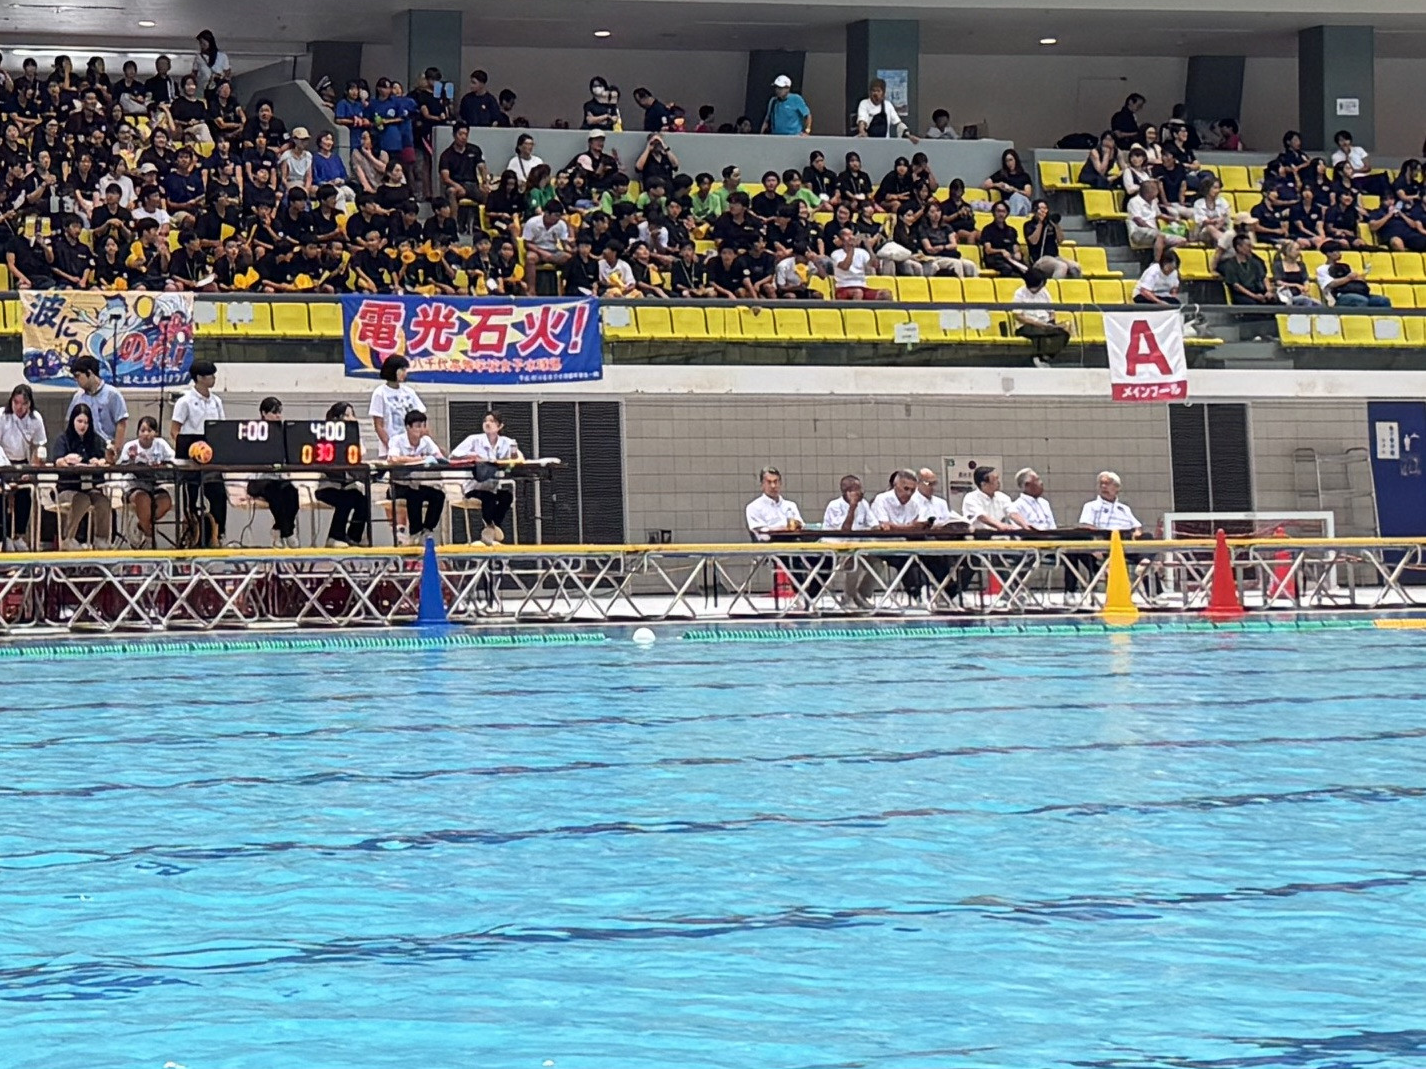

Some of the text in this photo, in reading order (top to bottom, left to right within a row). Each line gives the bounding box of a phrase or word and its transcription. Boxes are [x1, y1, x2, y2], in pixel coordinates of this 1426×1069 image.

[26, 293, 79, 338] 波に
[1126, 320, 1173, 376] A
[238, 421, 269, 441] 1:00
[310, 421, 346, 441] 4:00
[302, 443, 359, 464] 0 30 0
